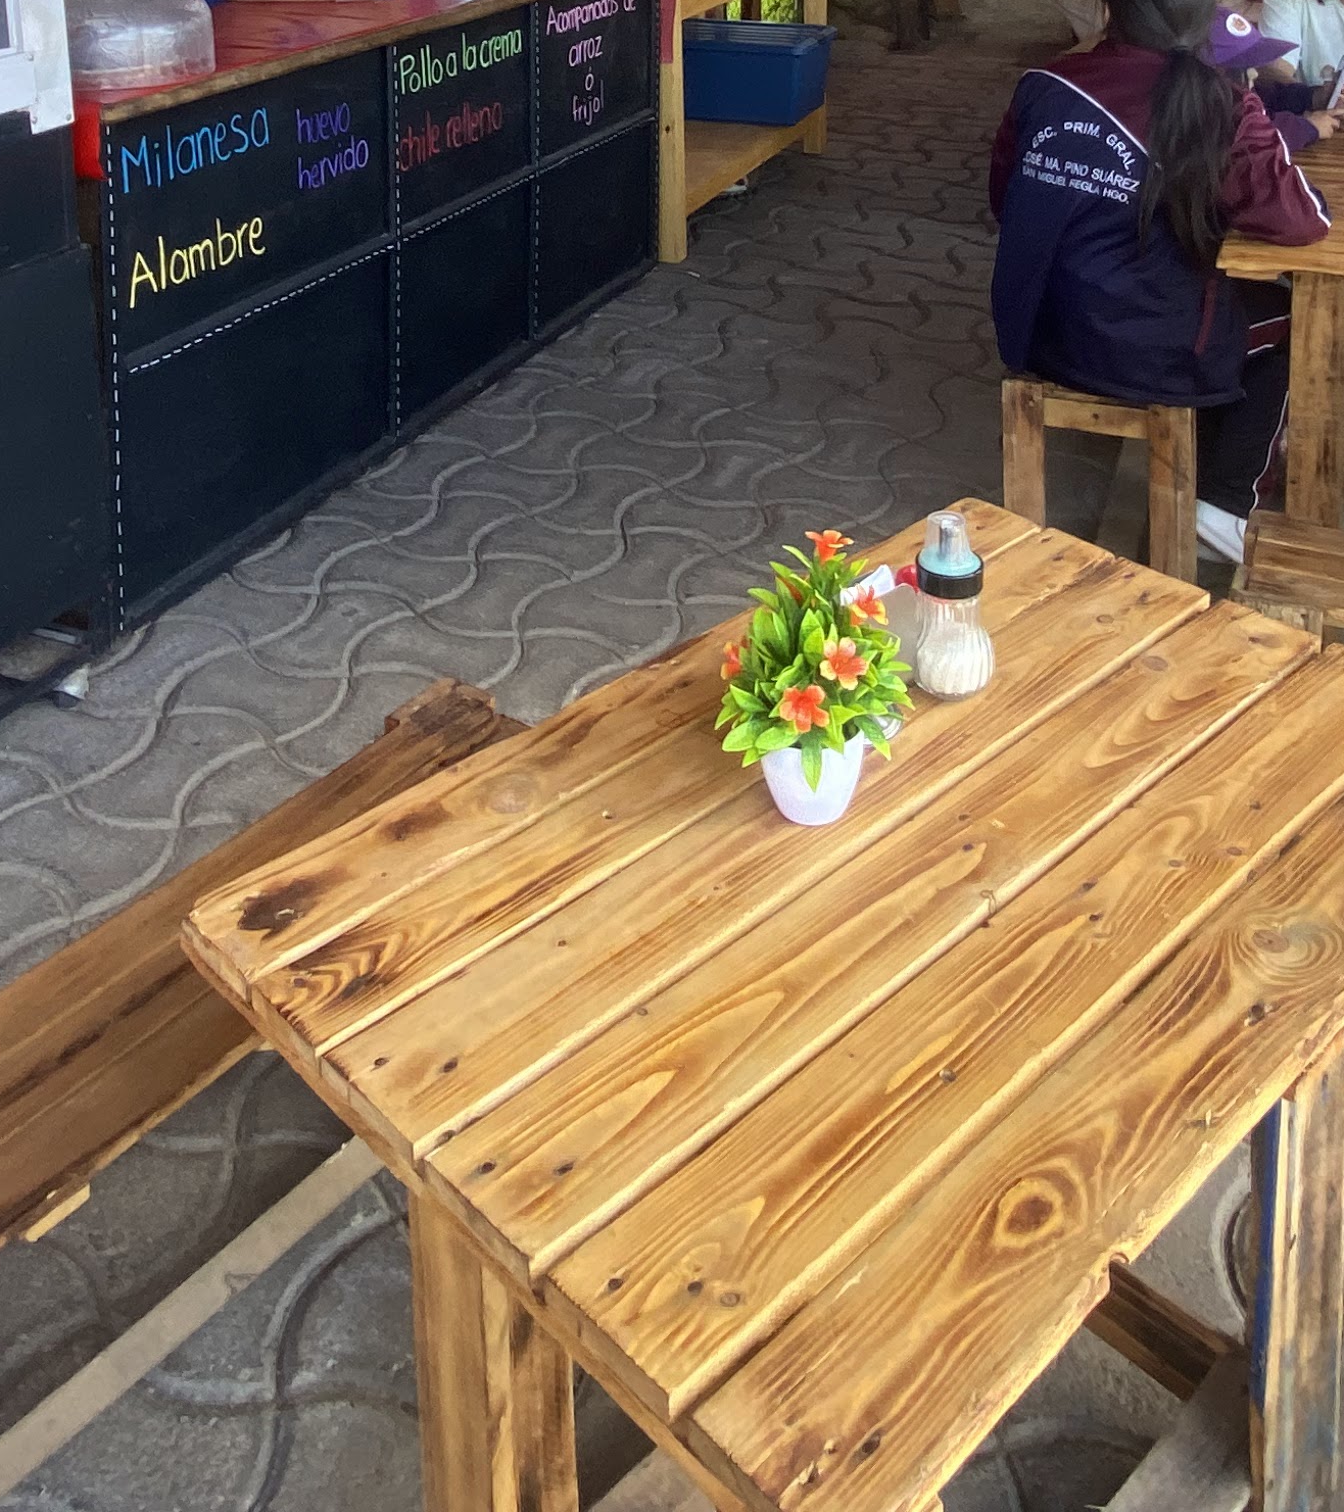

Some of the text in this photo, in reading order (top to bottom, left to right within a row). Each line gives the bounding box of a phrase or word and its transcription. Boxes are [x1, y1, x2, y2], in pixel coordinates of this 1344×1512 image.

[399, 29, 523, 95] Pollo a la crema
[568, 35, 604, 67] arroz
[296, 102, 351, 144] huevo
[572, 79, 605, 127] frijol
[120, 106, 270, 194] Milanesa
[297, 134, 370, 190] hervido
[400, 101, 503, 172] chile relleno
[128, 215, 267, 309] Alambre
